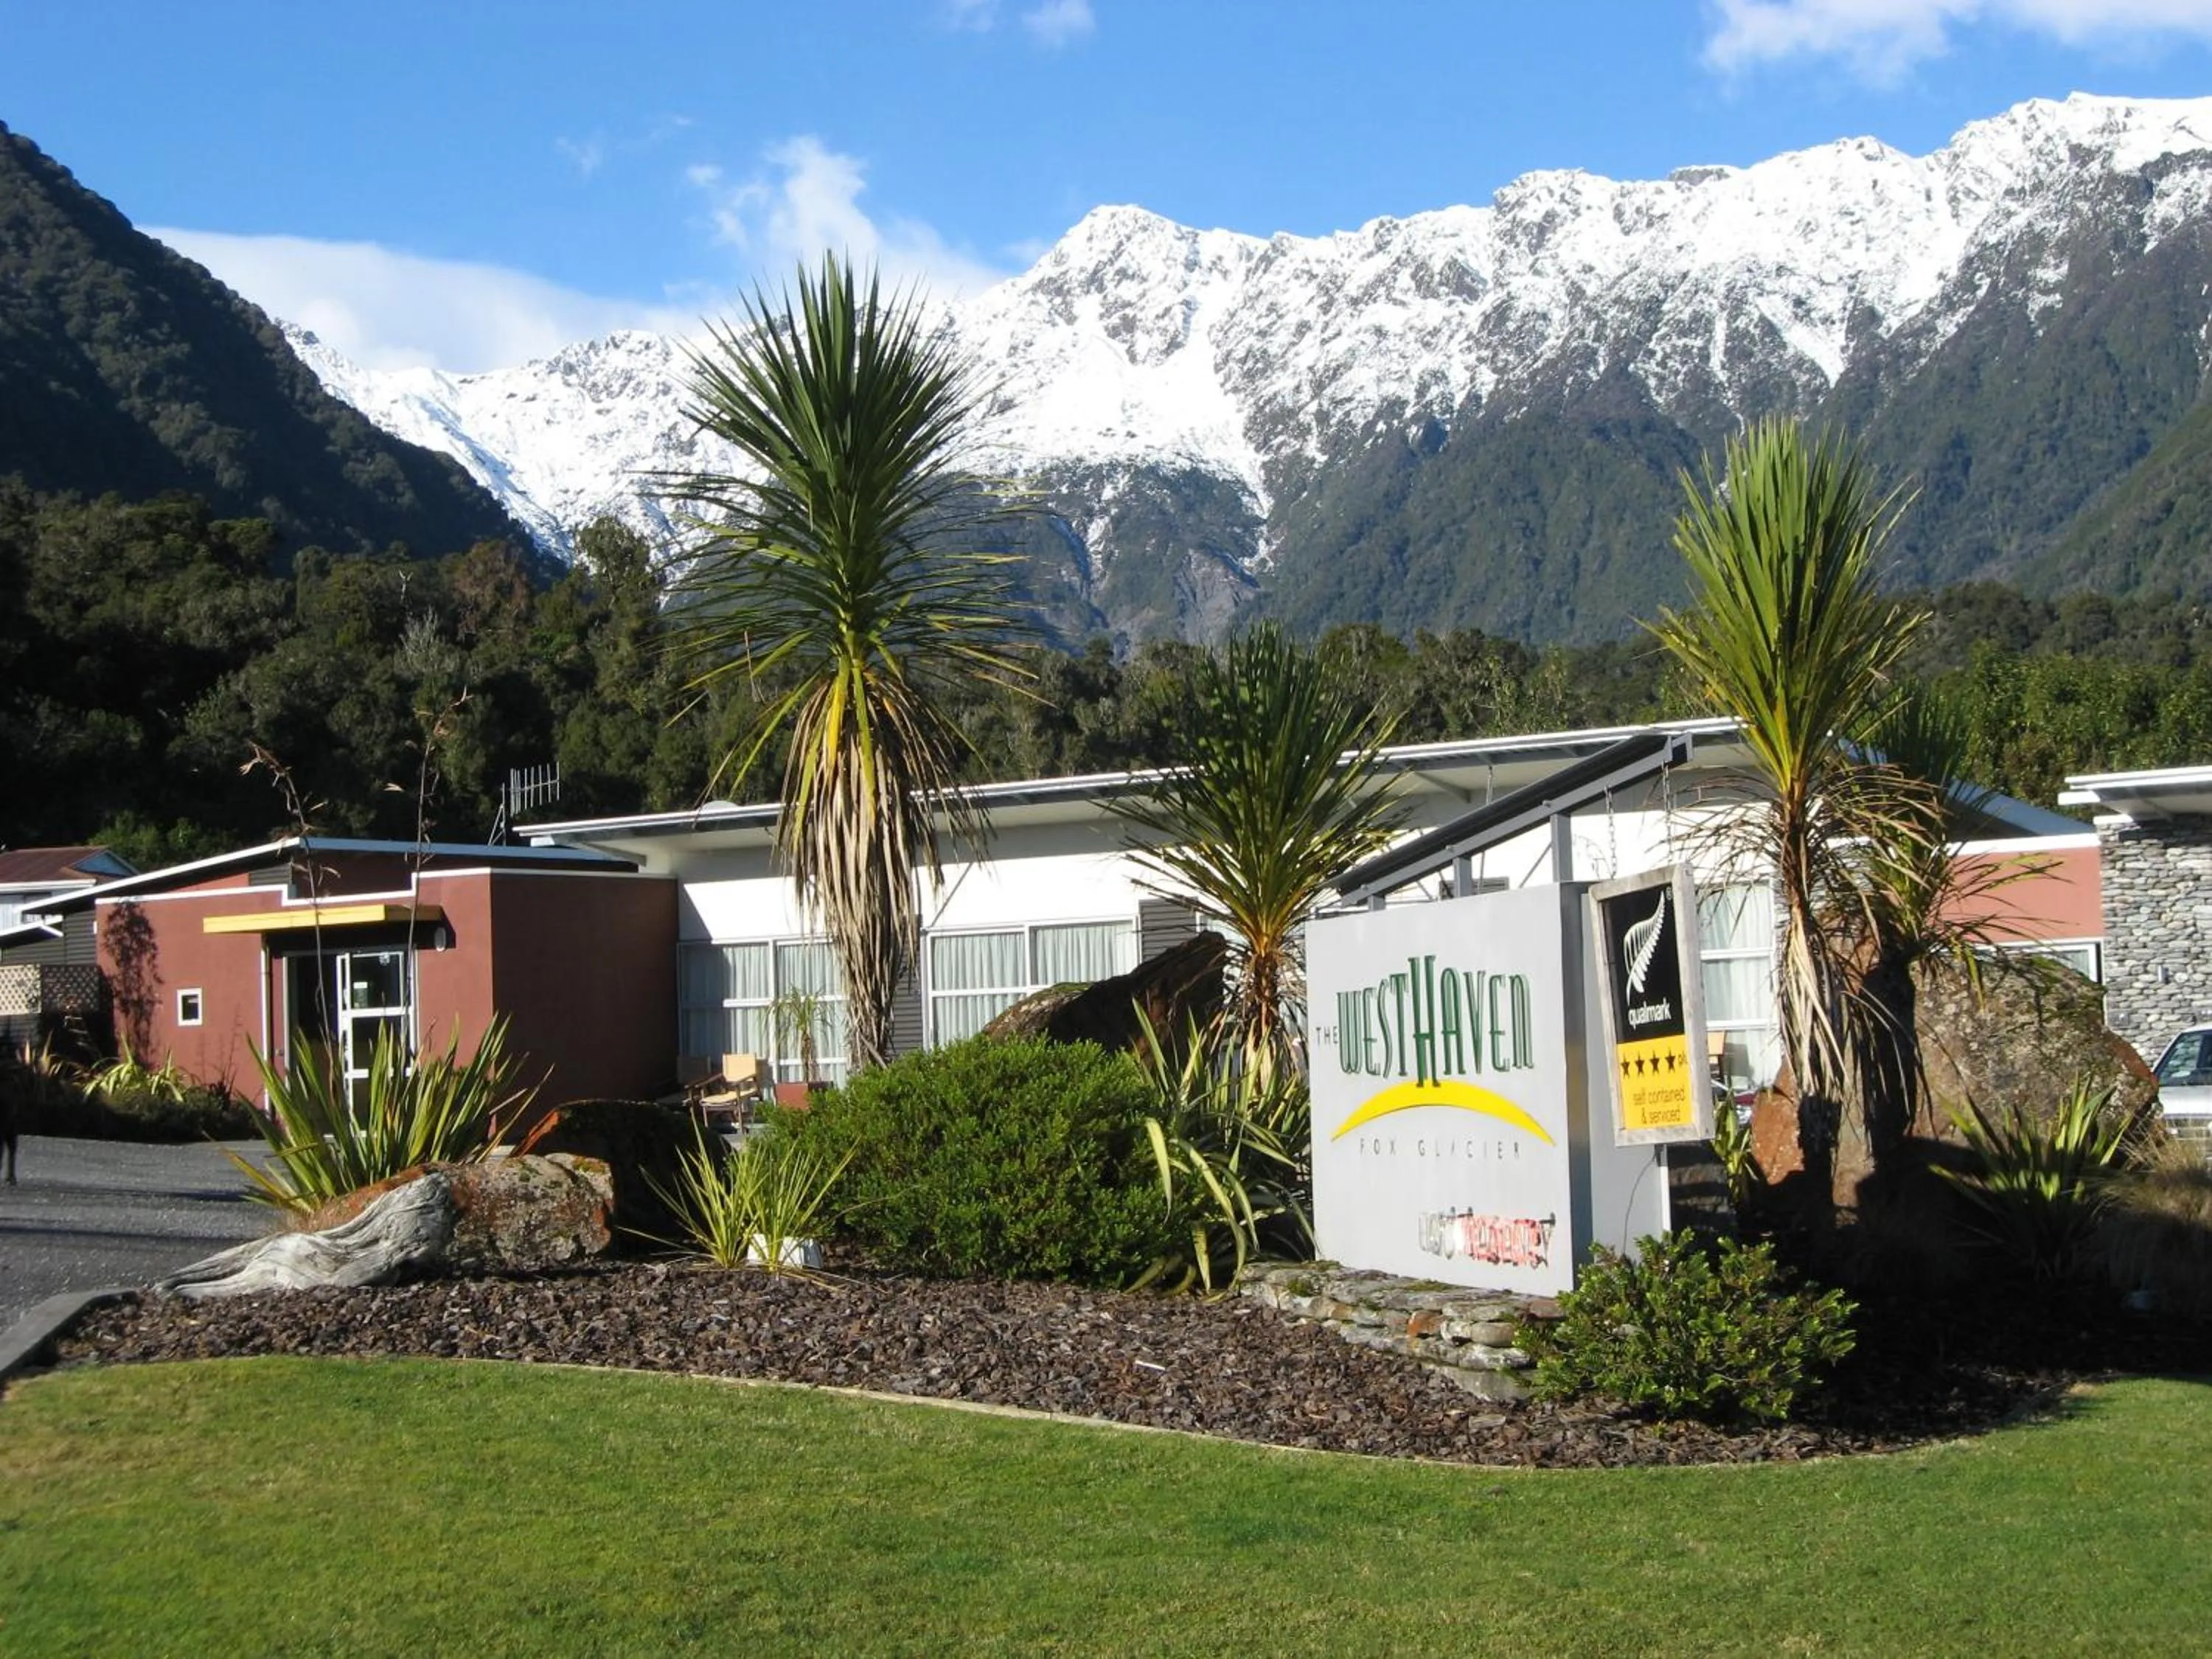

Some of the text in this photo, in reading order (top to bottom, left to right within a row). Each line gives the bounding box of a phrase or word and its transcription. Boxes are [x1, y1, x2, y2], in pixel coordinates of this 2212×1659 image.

[1628, 996, 1672, 1030] qualmark
[1315, 1026, 1338, 1046] THE
[1648, 1084, 1686, 1104] contained
[1649, 1106, 1681, 1124] serviced
[1360, 1137, 1520, 1161] FOX GLACIER
